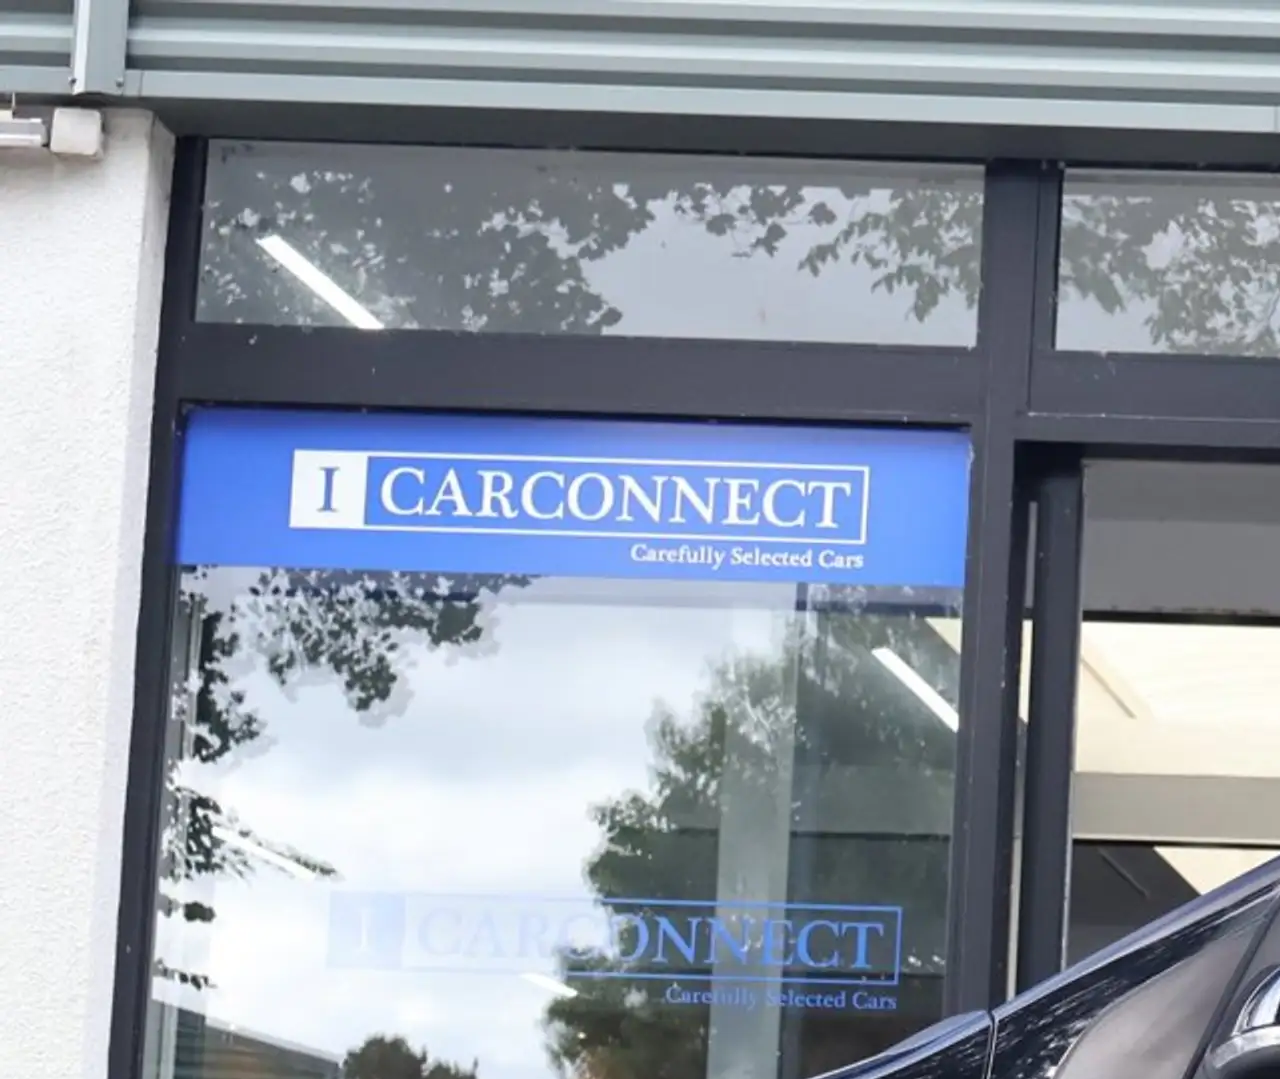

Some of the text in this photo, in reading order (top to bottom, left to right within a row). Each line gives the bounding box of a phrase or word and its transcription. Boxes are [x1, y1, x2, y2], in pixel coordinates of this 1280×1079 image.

[380, 464, 853, 530] CARCONNECT
[630, 543, 864, 570] Carefully Selected Cars
[418, 906, 884, 969] CARCONNECT
[666, 985, 897, 1010] Carefully Selected Cars
